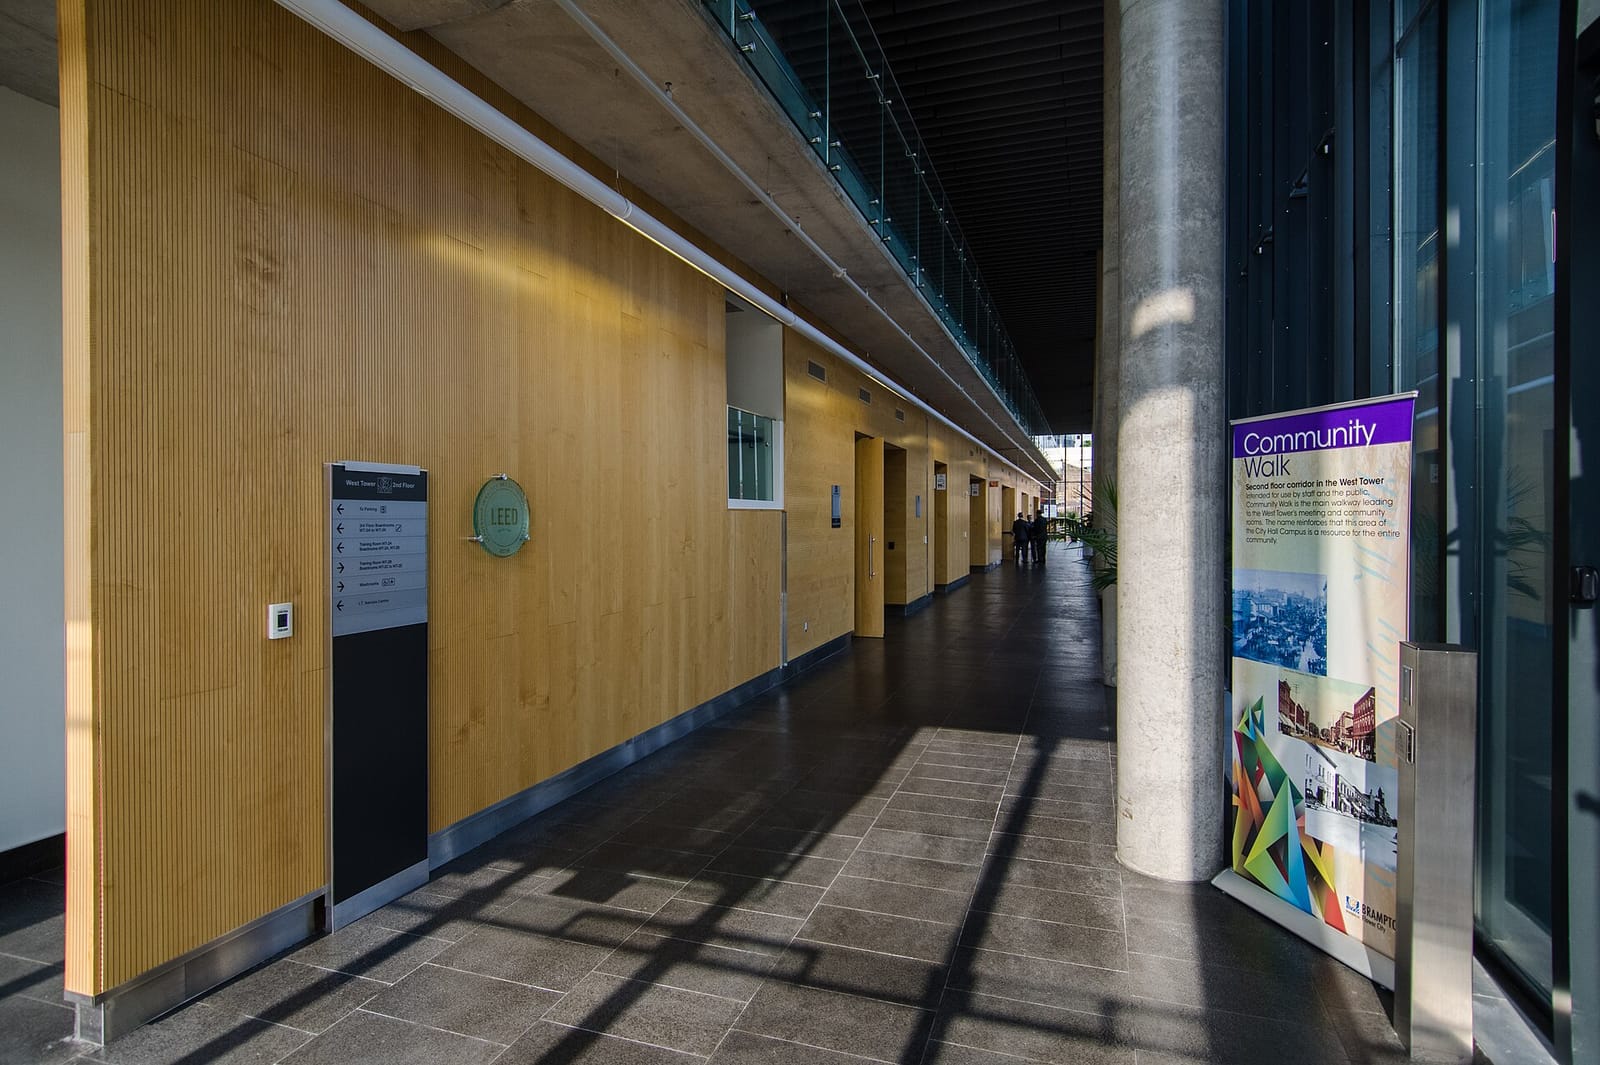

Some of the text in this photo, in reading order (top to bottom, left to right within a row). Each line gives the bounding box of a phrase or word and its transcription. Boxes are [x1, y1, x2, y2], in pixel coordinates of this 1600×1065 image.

[1244, 419, 1377, 455] Community
[1244, 455, 1291, 478] Walk
[345, 479, 376, 488] West Tower
[1246, 482, 1269, 491] Second
[1286, 480, 1315, 489] corridor
[1325, 479, 1338, 487] the
[1340, 478, 1358, 486] West
[1360, 477, 1385, 486] Tower
[1271, 491, 1280, 499] for
[1292, 490, 1301, 499] by
[1302, 490, 1316, 498] staff
[1316, 489, 1331, 497] and
[1246, 501, 1278, 509] Community
[1279, 500, 1293, 508] Walk
[1312, 499, 1330, 507] main
[1331, 499, 1361, 508] walkway
[1362, 498, 1394, 508] leading
[491, 507, 518, 525] LEED
[1276, 509, 1298, 517] Tower's
[1298, 509, 1326, 518] meeting
[1327, 509, 1342, 517] and
[1343, 508, 1386, 517] community
[1329, 519, 1344, 527] that
[1345, 519, 1357, 527] this
[1378, 519, 1387, 527] of
[1255, 528, 1267, 536] City
[1279, 528, 1307, 536] Campus
[1352, 529, 1361, 537] for
[1362, 529, 1376, 537] the
[1377, 529, 1400, 538] entire
[1362, 903, 1397, 932] BRAMPTO
[1376, 922, 1386, 934] City
